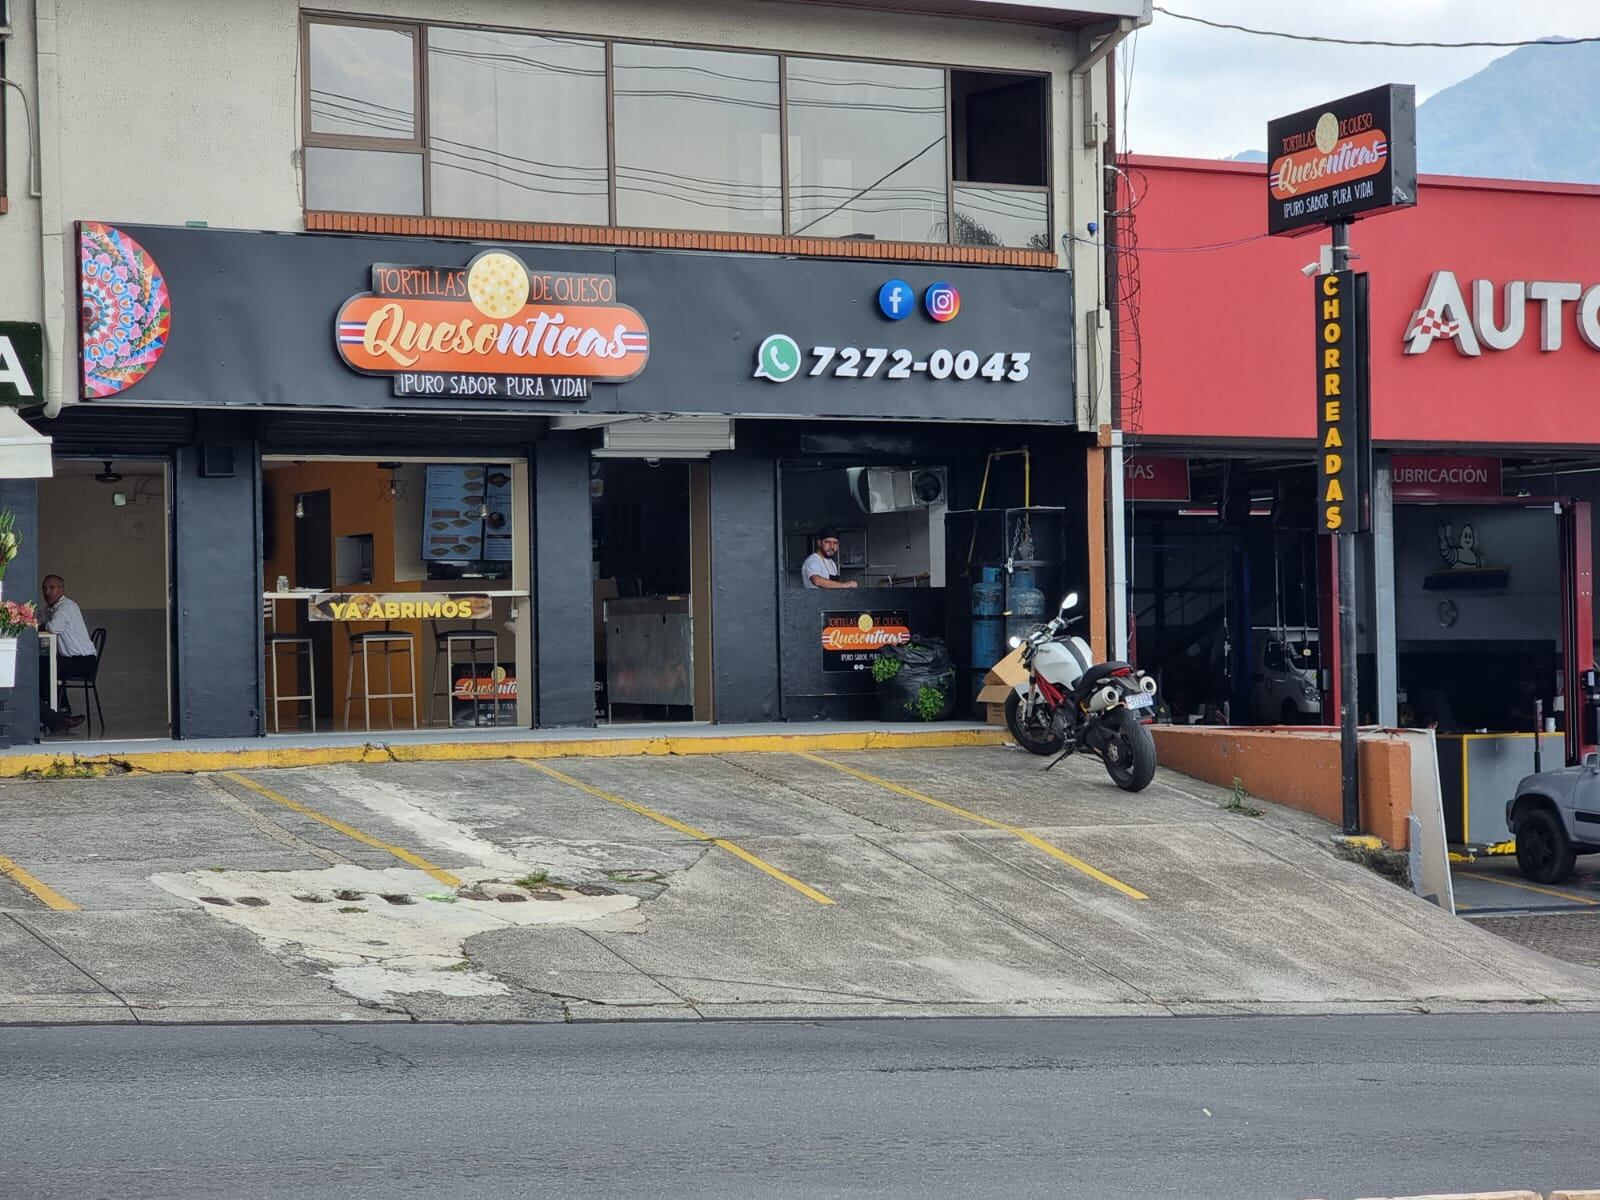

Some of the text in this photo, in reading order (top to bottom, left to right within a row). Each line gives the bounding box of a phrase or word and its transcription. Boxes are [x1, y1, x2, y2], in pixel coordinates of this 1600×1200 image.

[1282, 113, 1373, 154] TORTILLAS DE QUESO
[1278, 140, 1379, 194] Quesonticas
[1306, 193, 1329, 213] SABOR
[1332, 186, 1352, 207] PURA
[376, 268, 614, 302] TORTILLAS DE QUESO
[363, 303, 629, 367] Quesonticas
[809, 346, 1031, 381] 7272-0043
[450, 375, 497, 395] SABOR
[506, 377, 545, 396] PURA
[1323, 276, 1344, 530] CHORREADAS
[1392, 465, 1488, 483] UBRICACIÓN
[329, 601, 473, 619] YA ABRIMOS
[829, 629, 903, 648] Quesonticas
